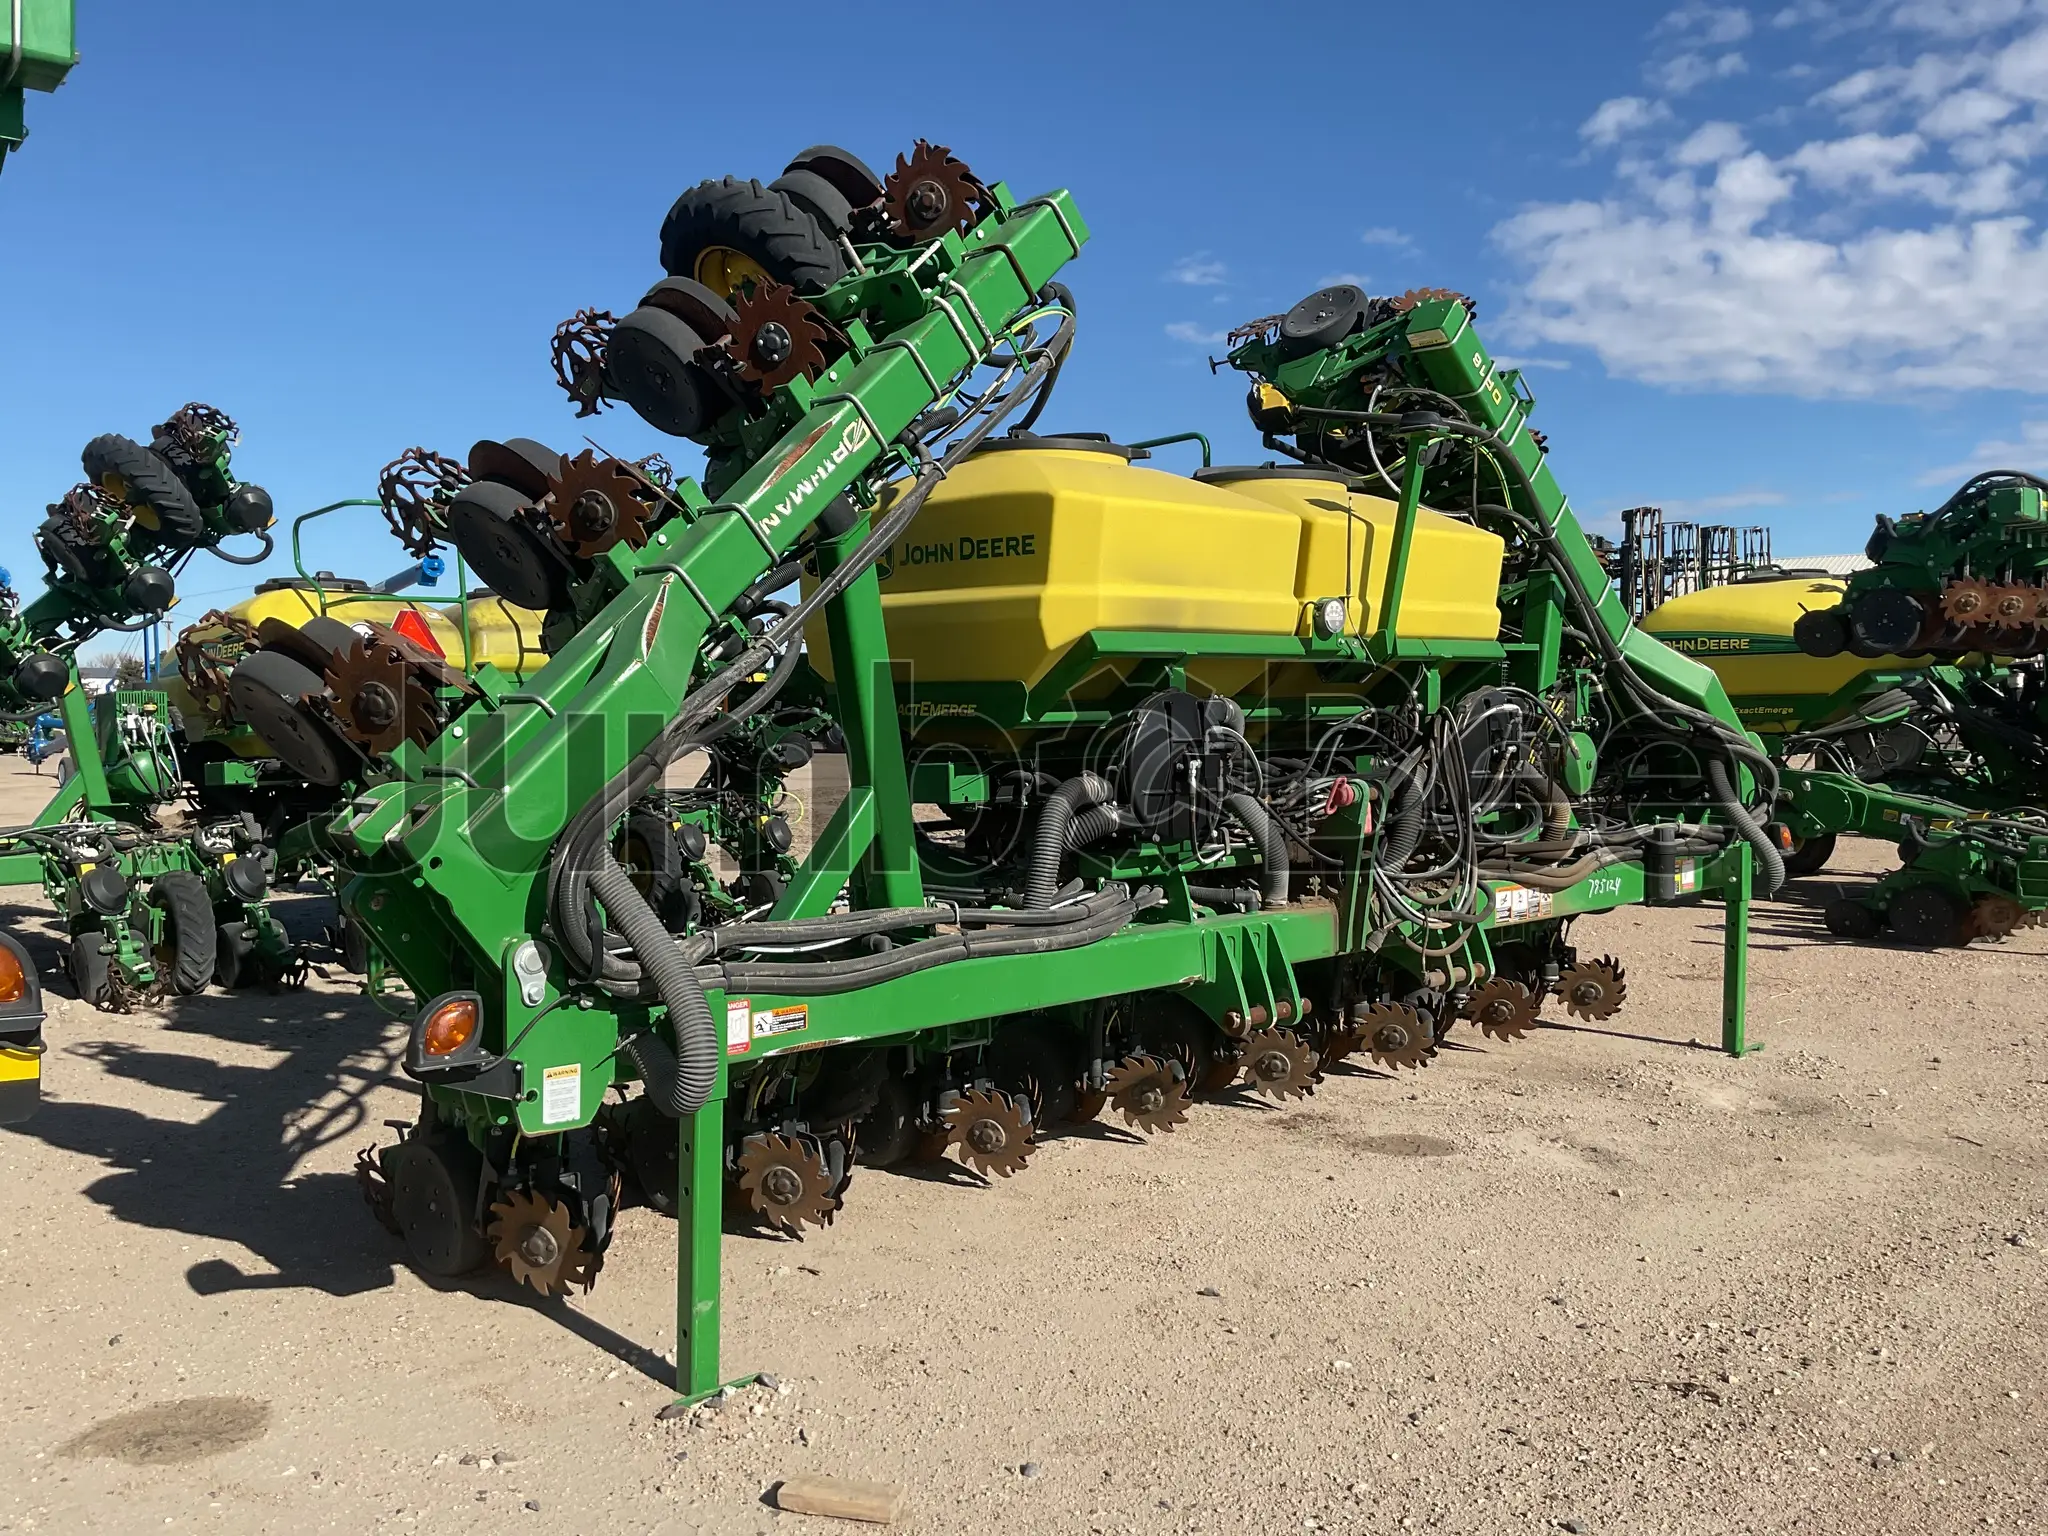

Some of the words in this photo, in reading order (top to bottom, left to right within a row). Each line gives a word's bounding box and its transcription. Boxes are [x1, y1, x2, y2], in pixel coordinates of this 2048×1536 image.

[900, 543, 953, 566] JOHN
[959, 534, 1035, 561] DEERE
[1662, 640, 1695, 651] OHN
[1697, 637, 1750, 650] DEERE
[897, 701, 977, 717] ACTEMERGE
[727, 1001, 749, 1009] ANGER
[553, 1068, 577, 1077] WARNING
